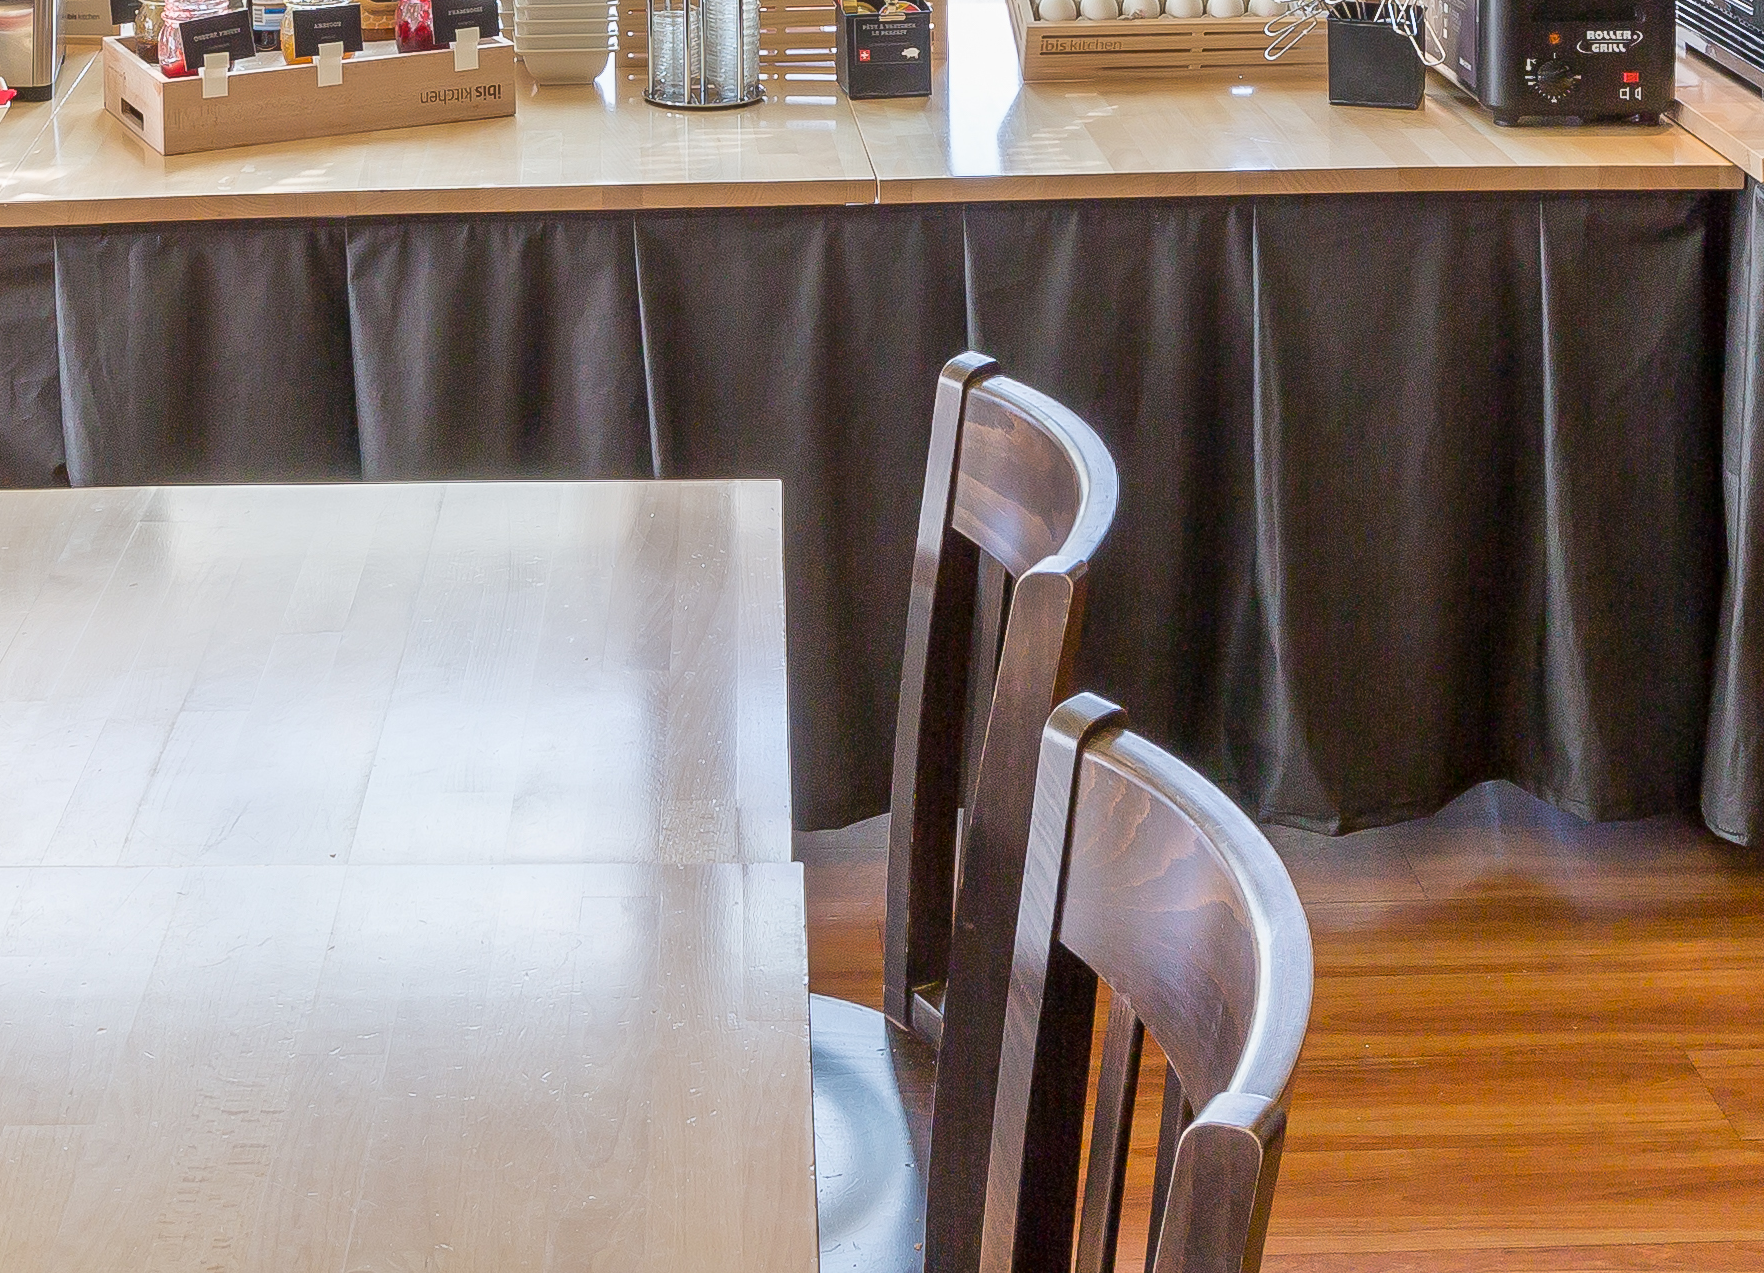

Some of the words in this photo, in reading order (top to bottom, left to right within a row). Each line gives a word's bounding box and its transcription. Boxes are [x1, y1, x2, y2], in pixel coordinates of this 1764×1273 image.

[1586, 30, 1632, 40] ROLLER
[1040, 39, 1066, 51] ibis
[1070, 39, 1122, 51] kitchen
[1591, 43, 1626, 53] GRILL
[420, 87, 472, 105] kitchen
[475, 83, 502, 100] ibis
